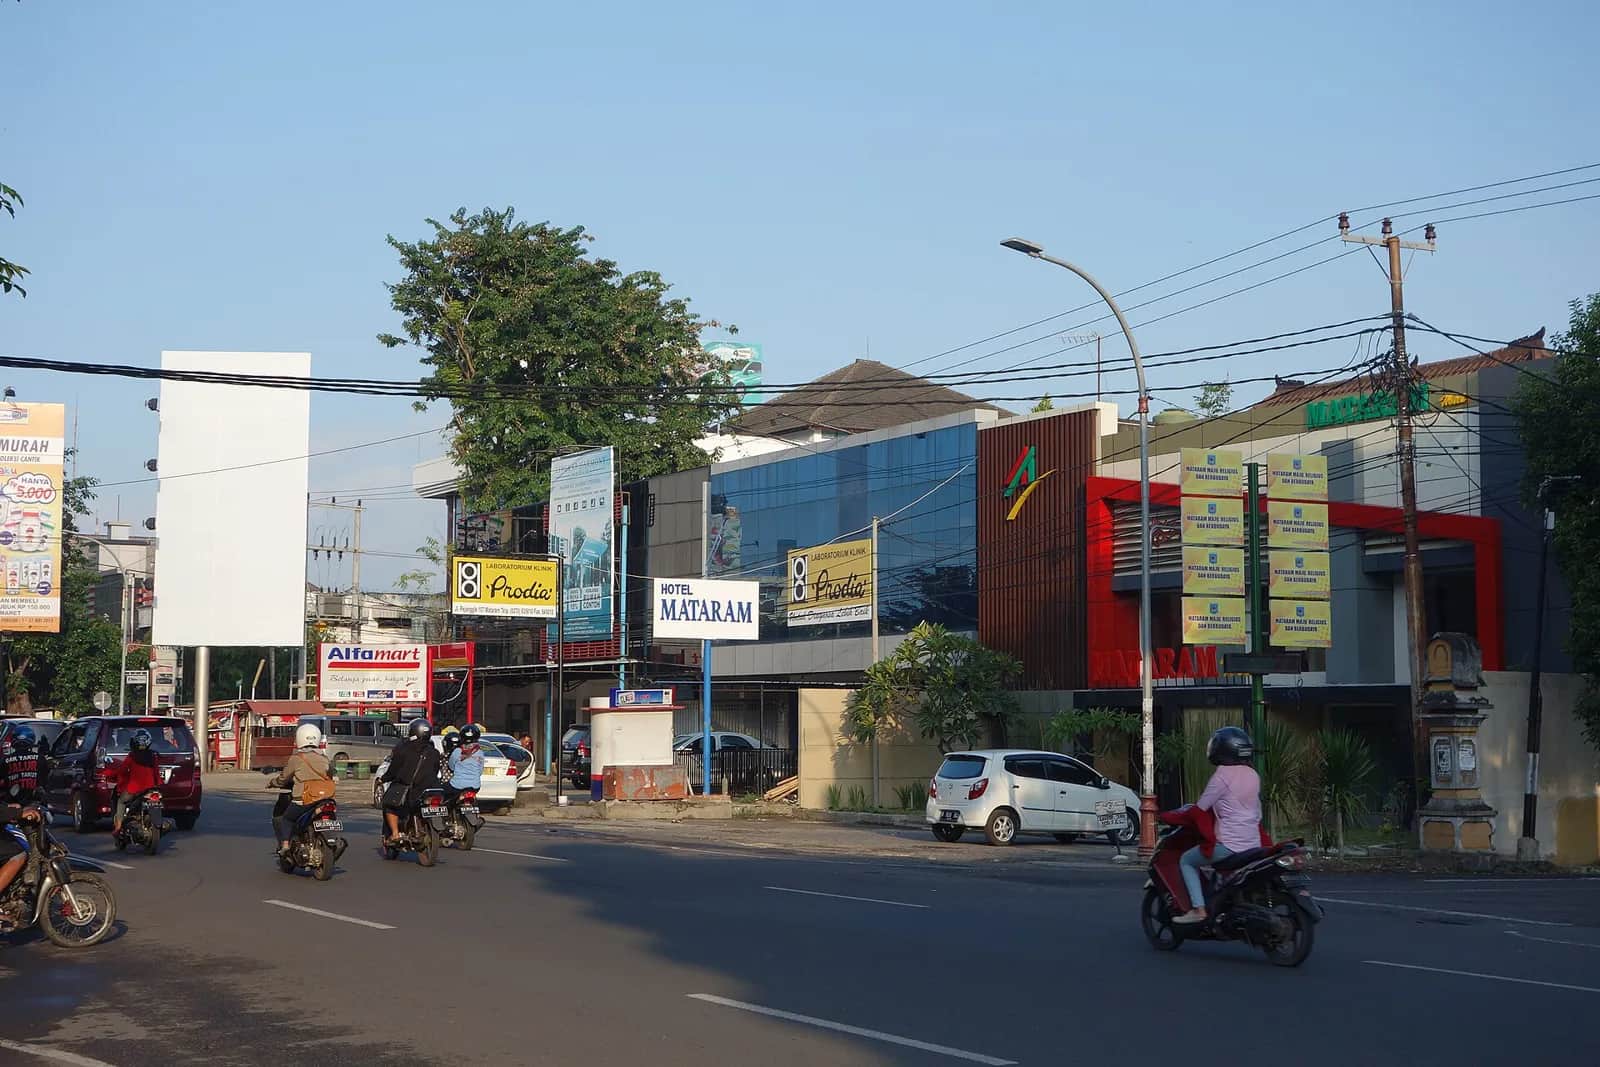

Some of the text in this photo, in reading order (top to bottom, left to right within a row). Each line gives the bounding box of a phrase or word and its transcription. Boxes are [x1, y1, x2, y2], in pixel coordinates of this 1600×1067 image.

[0, 439, 49, 453] MURAH
[21, 477, 49, 485] HANYA
[16, 485, 52, 500] 5.000
[811, 548, 867, 561] LABORATORIUM KLINIK
[487, 575, 552, 600] Prodia
[661, 584, 693, 595] HOTEL
[813, 569, 867, 602] Prodia
[660, 598, 752, 624] MATARAM
[328, 647, 420, 660] Alfamart
